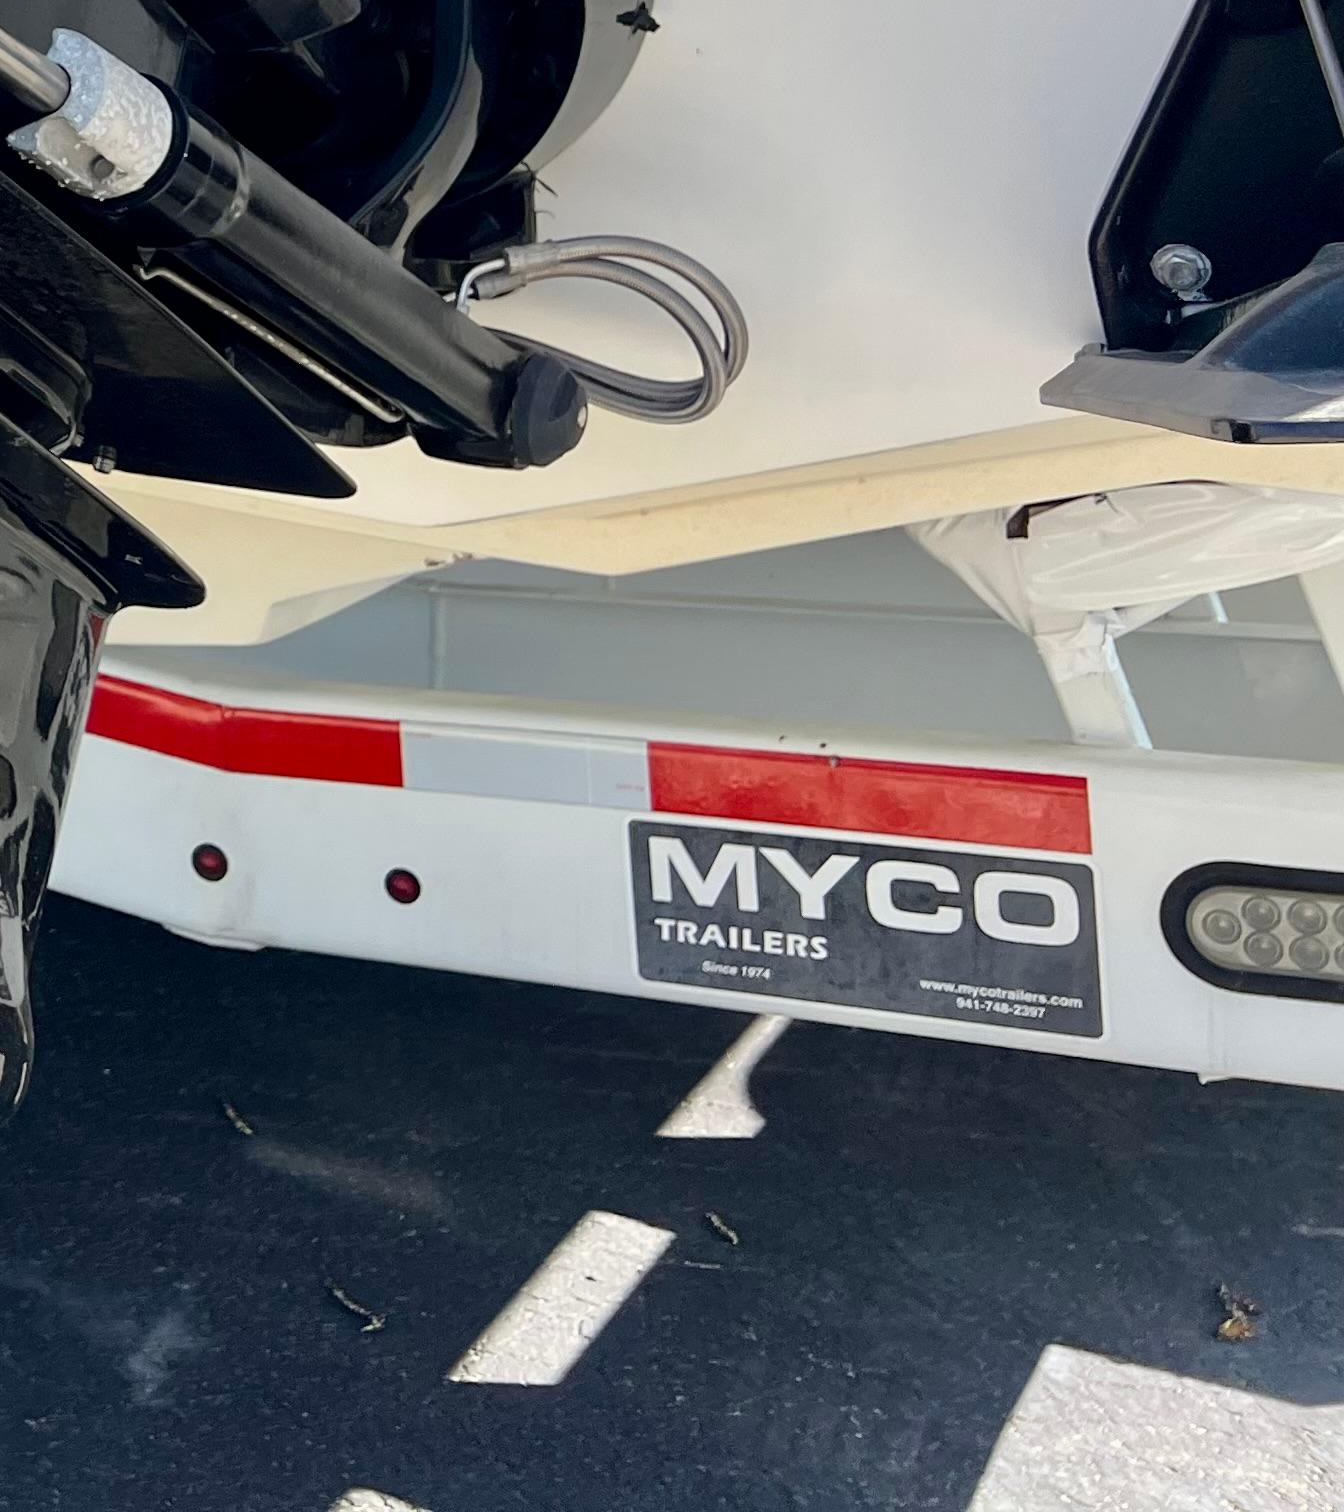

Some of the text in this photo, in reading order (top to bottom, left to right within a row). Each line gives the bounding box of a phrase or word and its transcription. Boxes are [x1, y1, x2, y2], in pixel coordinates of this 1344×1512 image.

[648, 835, 1080, 946] MYCO
[653, 917, 829, 960] TRAILERS
[919, 979, 1084, 1009] www.mycotrailers.com
